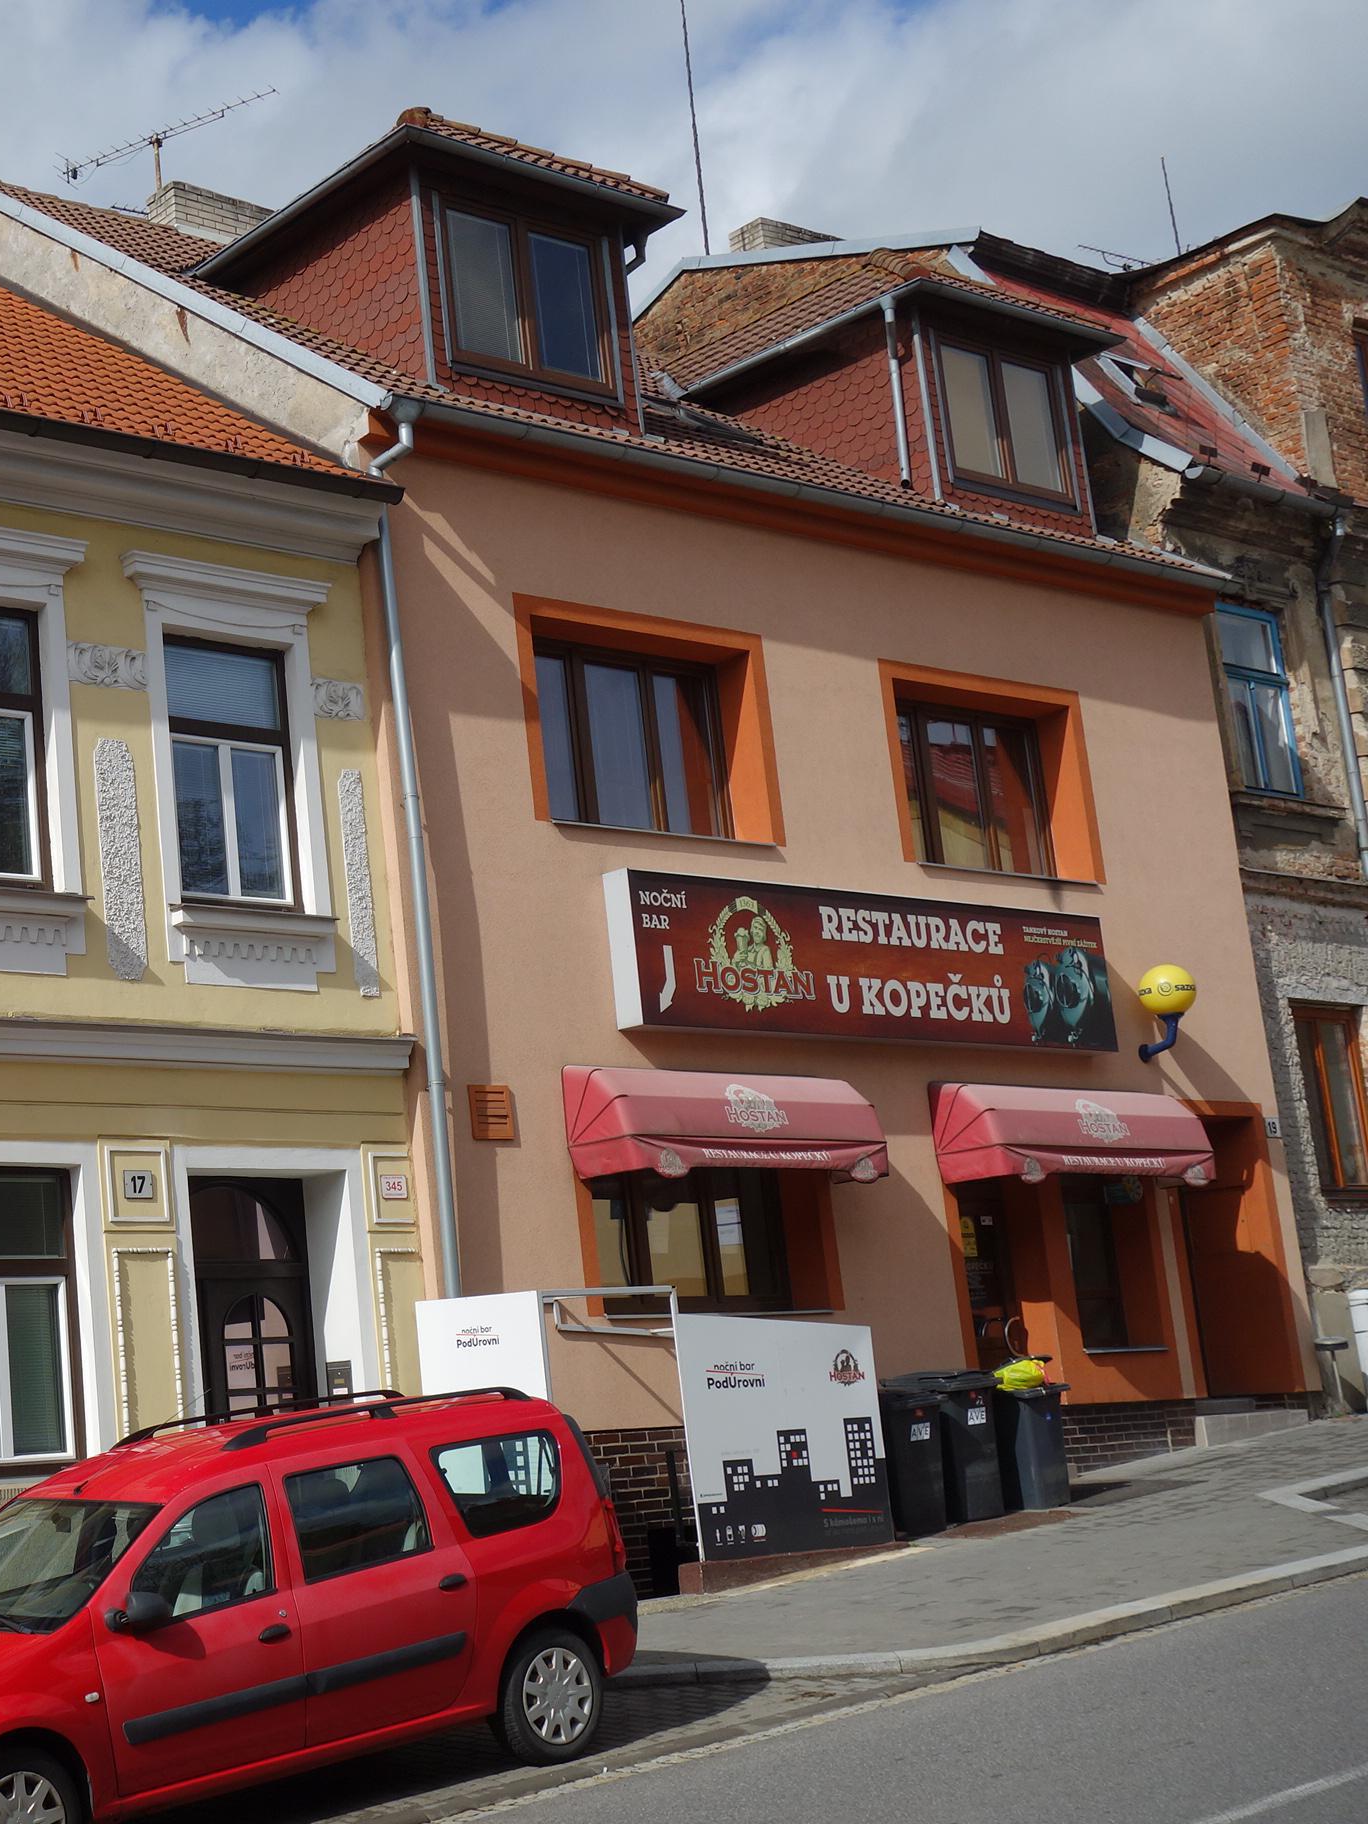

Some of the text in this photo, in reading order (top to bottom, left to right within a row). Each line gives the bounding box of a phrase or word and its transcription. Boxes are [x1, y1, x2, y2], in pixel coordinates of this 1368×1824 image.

[639, 888, 687, 909] NOČNÍ
[642, 913, 670, 929] BAR
[818, 905, 1005, 955] RESTAURACE
[693, 957, 817, 1001] HOSTAN
[826, 972, 1012, 1024] U KOPEČKŮ
[726, 1106, 788, 1125] HOSTAN
[1078, 1120, 1130, 1136] HOSTAN
[1267, 1121, 1278, 1135] 19
[130, 1175, 146, 1194] 17
[385, 1181, 403, 1192] 345
[480, 1325, 493, 1333] bar
[739, 1360, 755, 1371] bar
[829, 1370, 865, 1383] HOSTAN
[968, 1409, 985, 1421] AVE
[911, 1425, 929, 1437] AVE
